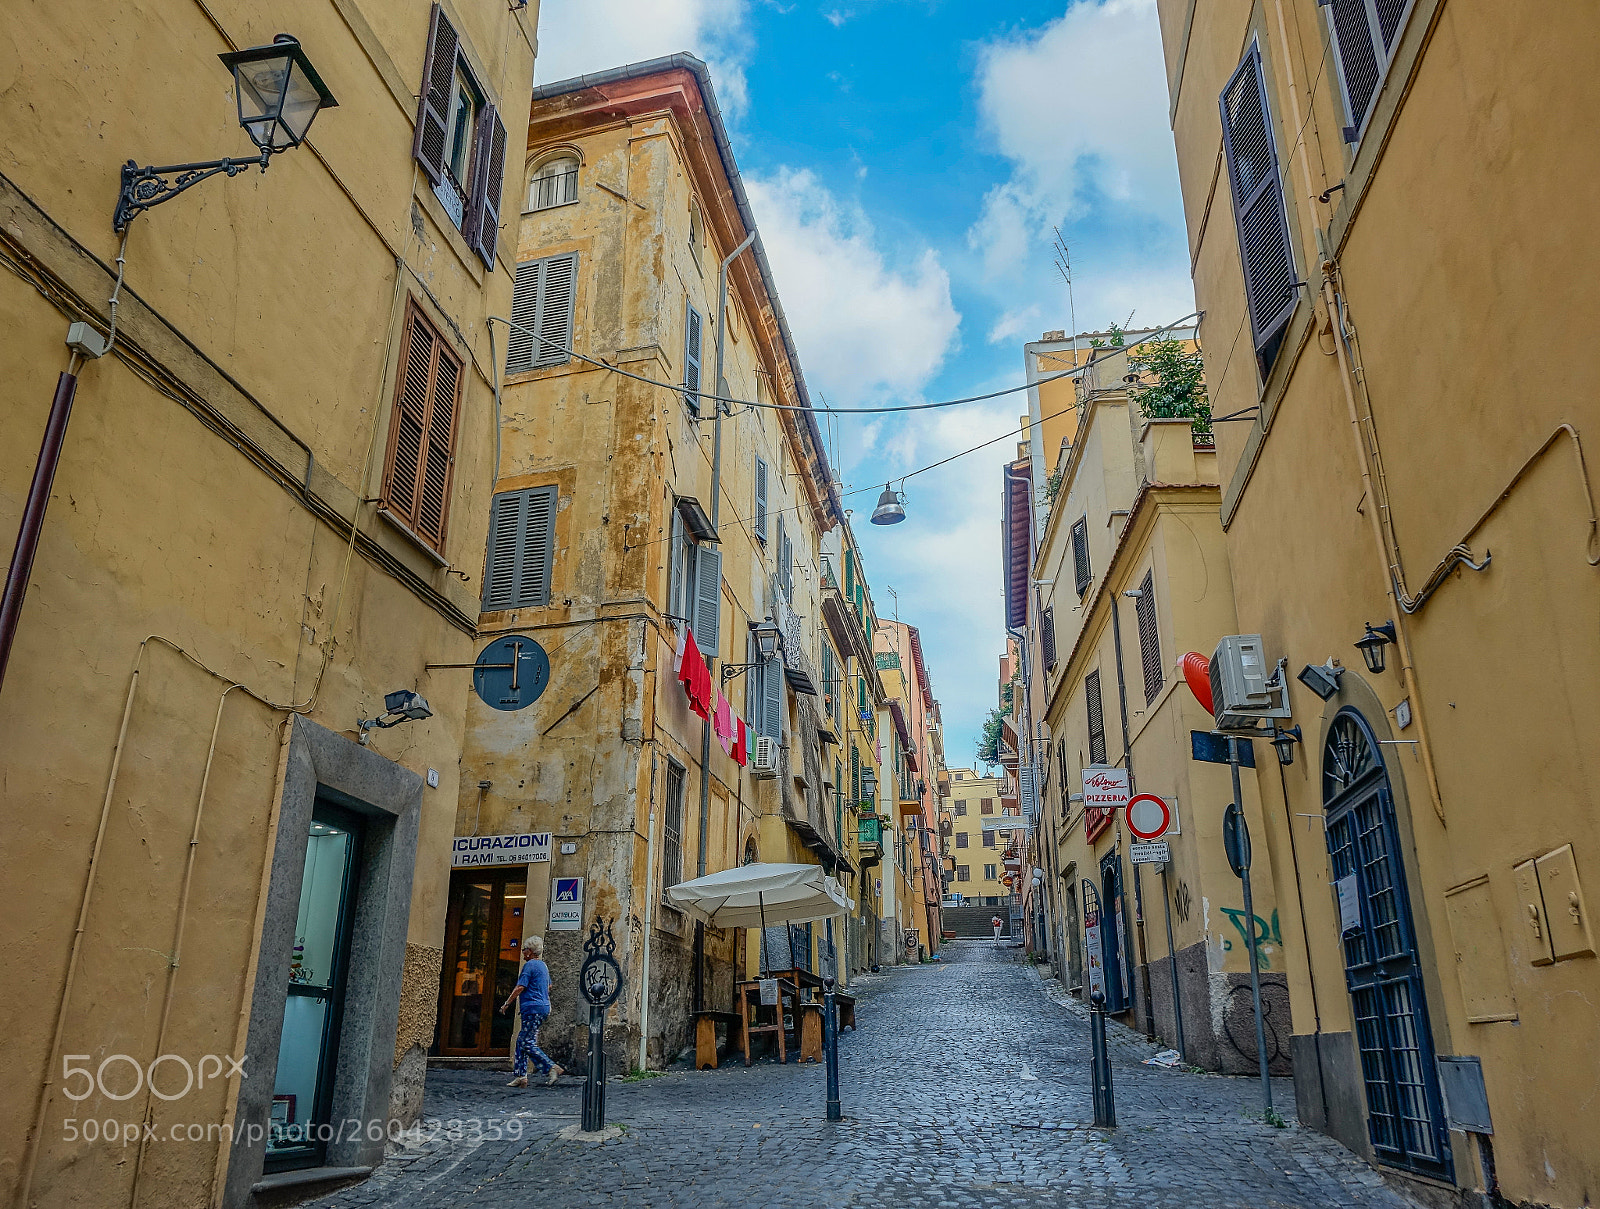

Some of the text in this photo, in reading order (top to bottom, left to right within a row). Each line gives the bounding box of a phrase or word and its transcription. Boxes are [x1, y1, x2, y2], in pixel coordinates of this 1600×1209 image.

[1087, 794, 1127, 802] PIZZERIA
[453, 834, 549, 851] ICURAZIONI
[462, 853, 494, 864] RAMI
[556, 890, 574, 901] AXA
